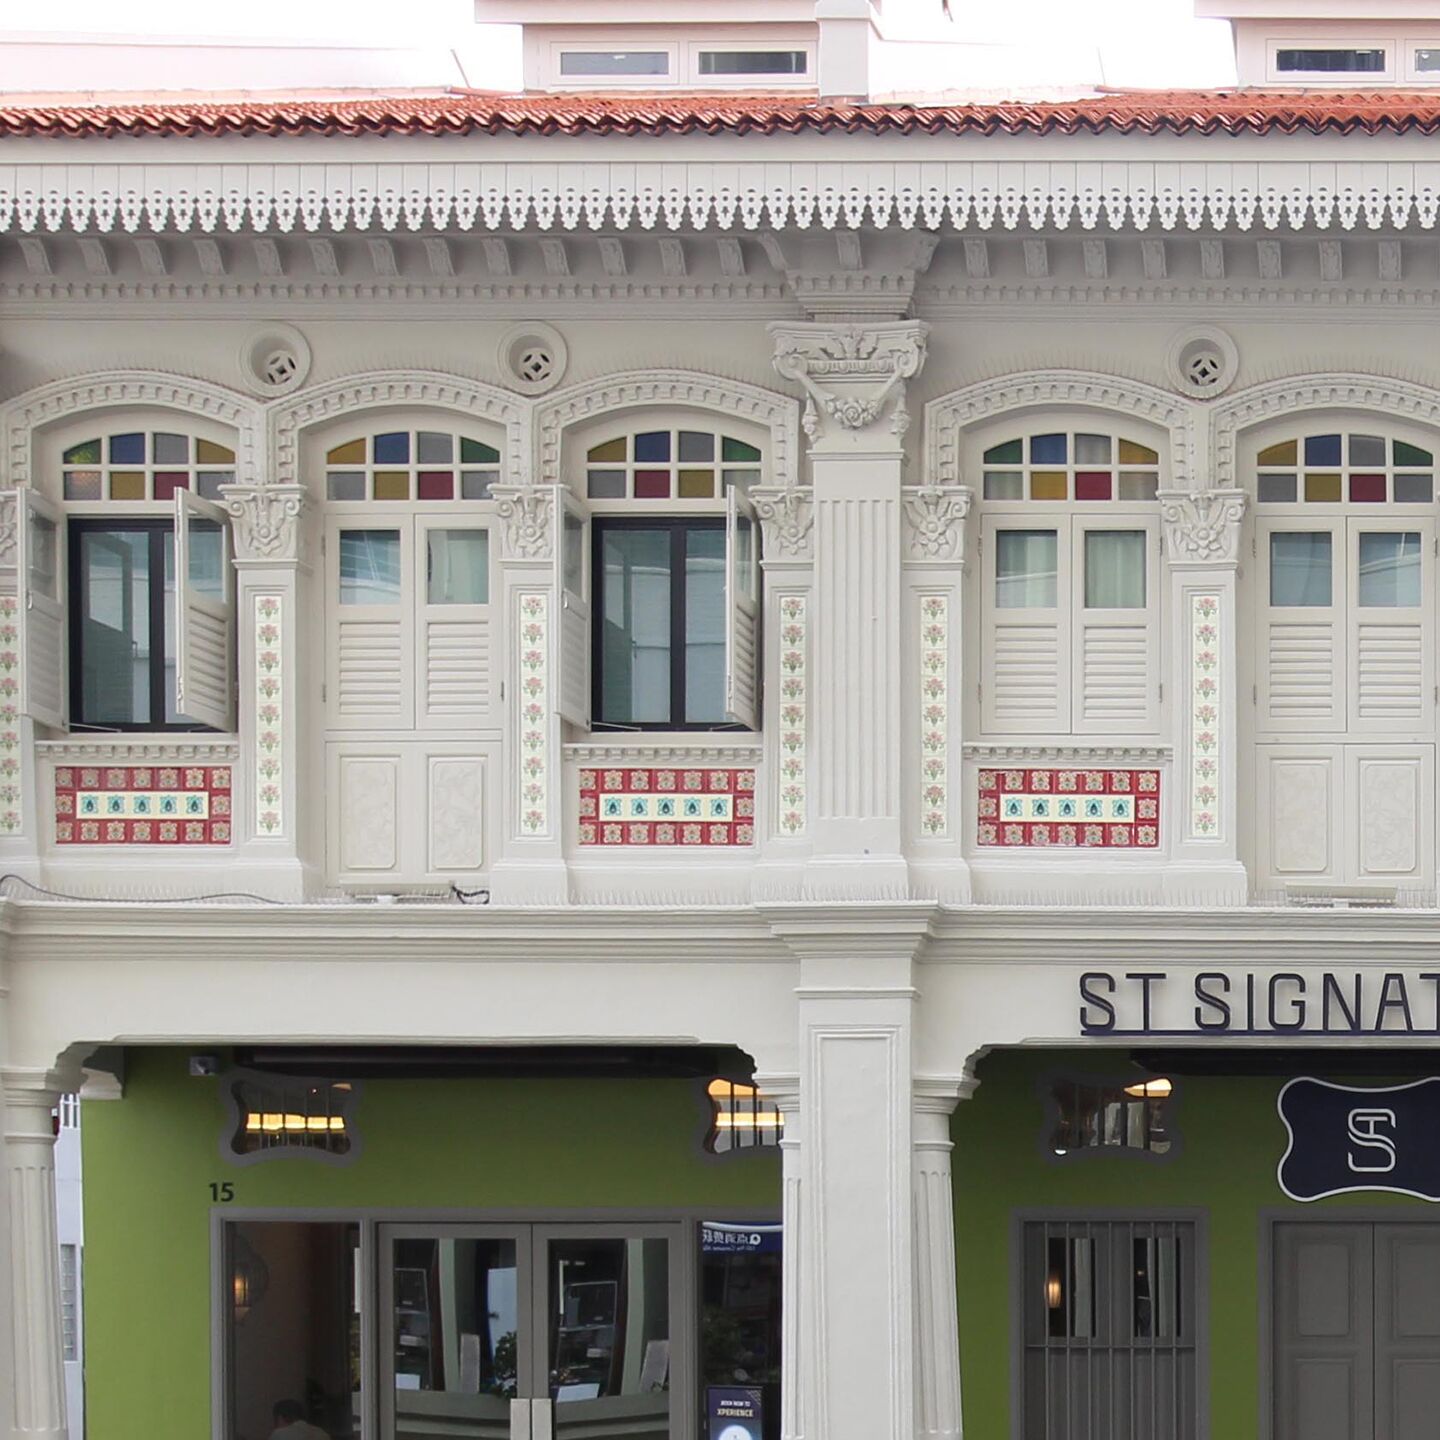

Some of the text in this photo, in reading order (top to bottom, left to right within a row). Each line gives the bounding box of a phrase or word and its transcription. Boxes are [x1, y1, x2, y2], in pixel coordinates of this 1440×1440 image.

[1080, 973, 1167, 1032] ST
[209, 1182, 234, 1202] 15
[717, 1408, 753, 1417] XPERIENCE
